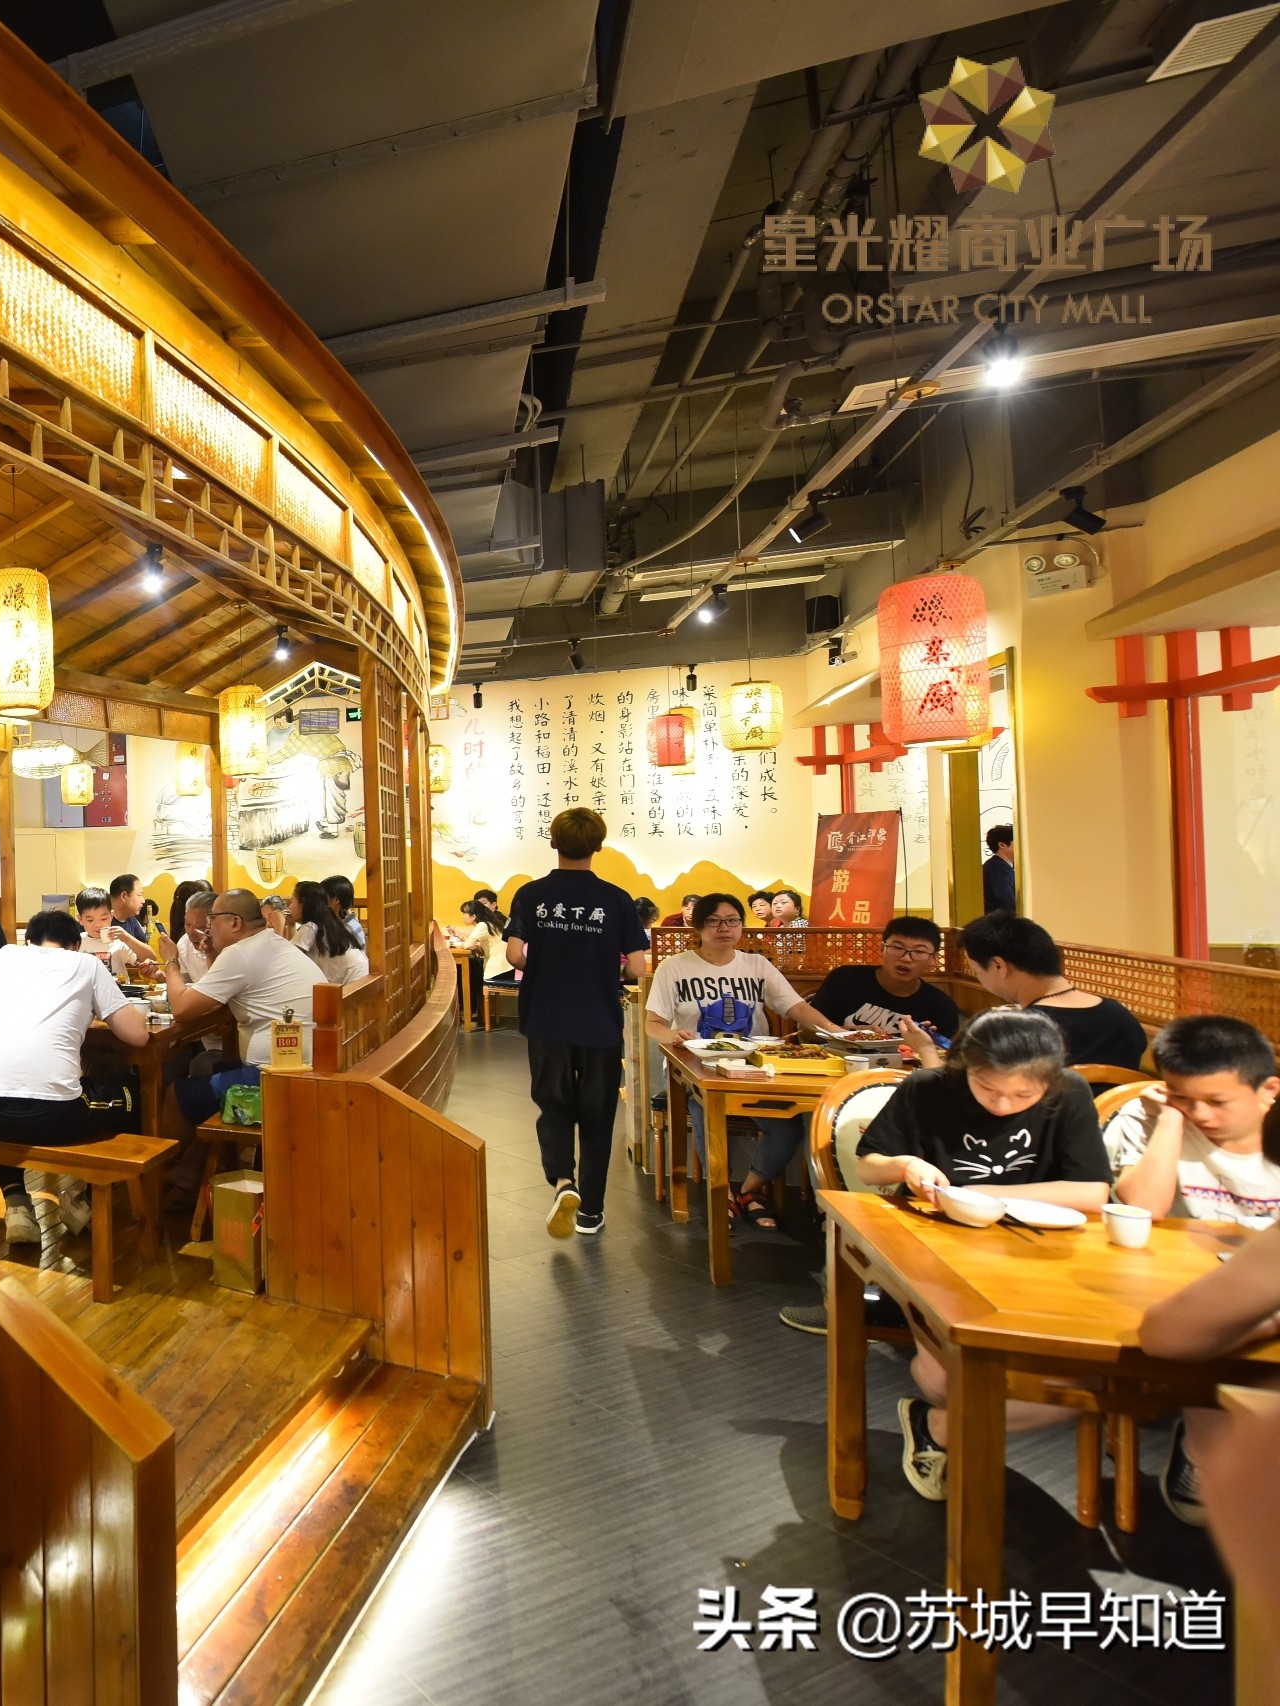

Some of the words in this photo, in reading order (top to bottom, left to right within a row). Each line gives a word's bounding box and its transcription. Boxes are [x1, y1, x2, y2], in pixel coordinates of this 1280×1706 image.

[536, 903, 606, 924] 为爱下厨
[537, 920, 569, 931] Coking
[571, 922, 584, 931] for
[585, 925, 603, 934] love
[278, 1038, 297, 1047] B09
